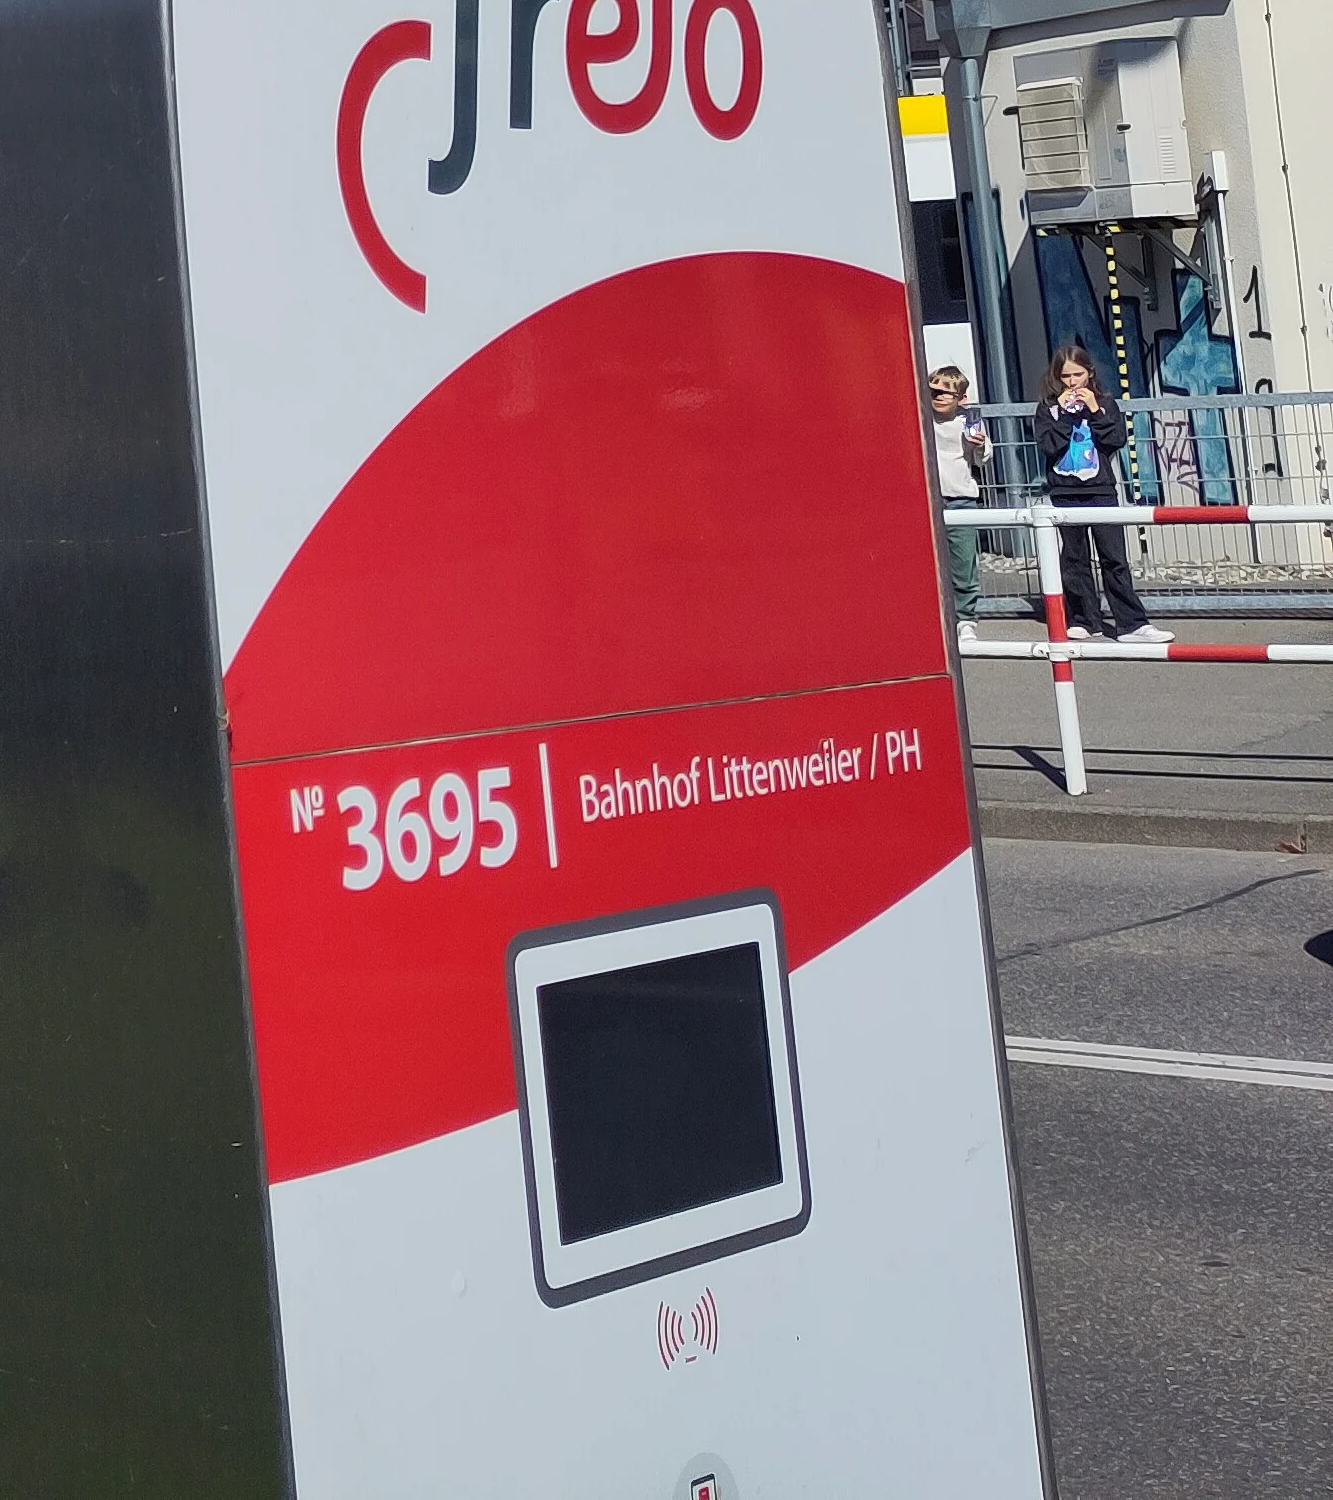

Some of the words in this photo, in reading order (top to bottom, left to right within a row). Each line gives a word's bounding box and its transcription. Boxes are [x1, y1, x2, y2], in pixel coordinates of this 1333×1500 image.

[336, 765, 519, 892] 3695
[579, 755, 701, 823] Bahnhof
[706, 737, 862, 803] Littenweiler
[869, 732, 879, 781] /
[884, 727, 922, 775] PH
